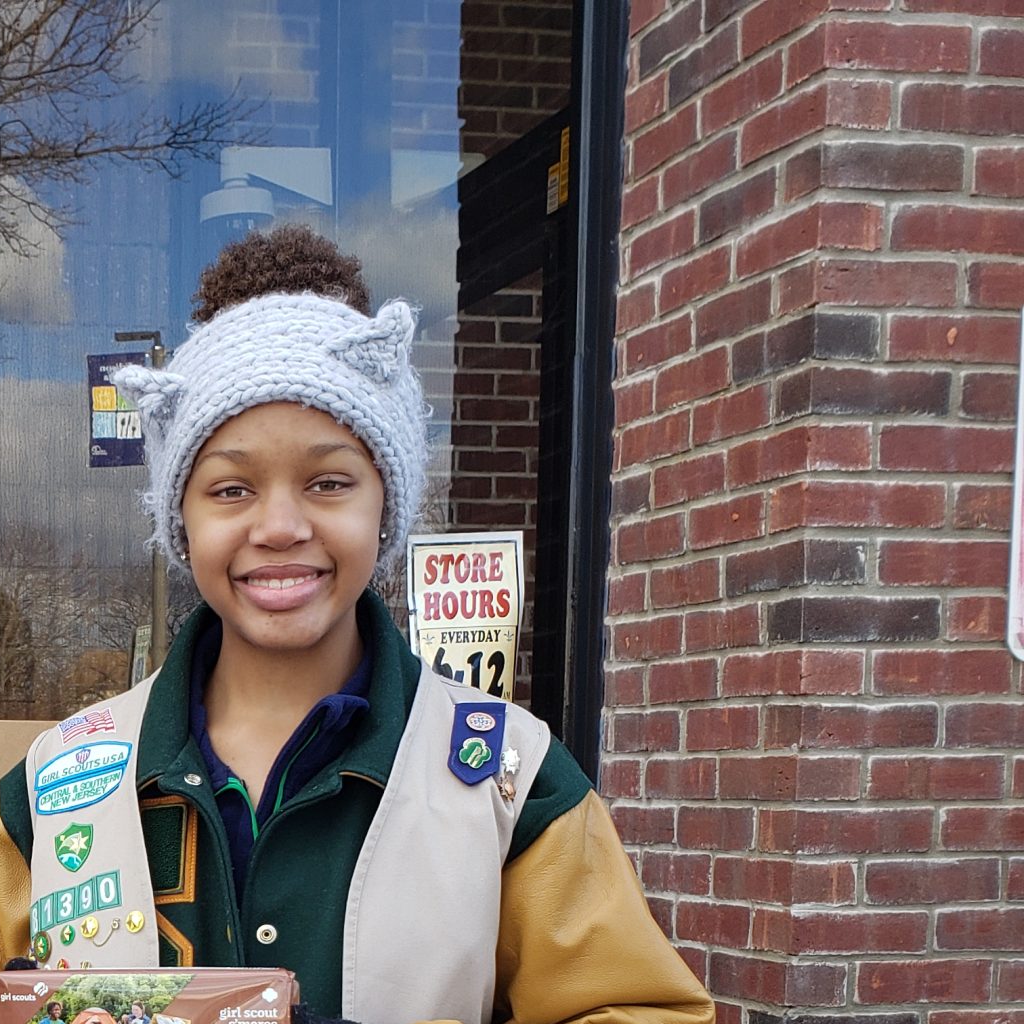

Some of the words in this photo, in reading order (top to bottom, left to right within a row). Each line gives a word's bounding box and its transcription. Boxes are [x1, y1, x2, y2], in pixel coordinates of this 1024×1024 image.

[423, 552, 504, 585] STORE
[423, 588, 511, 621] HOURS
[441, 629, 502, 644] EVERYDAY
[41, 771, 60, 785] GIRL
[62, 758, 101, 777] SCOUTS
[102, 751, 125, 765] USA
[40, 786, 71, 806] CENTRAL
[80, 772, 120, 791] SOUTHERN
[50, 796, 71, 810] NEW
[72, 784, 107, 801] JERSEY
[0, 991, 14, 1002] girl
[14, 991, 37, 1002] scouts
[219, 1006, 241, 1020] girl
[243, 1007, 278, 1018] scout
